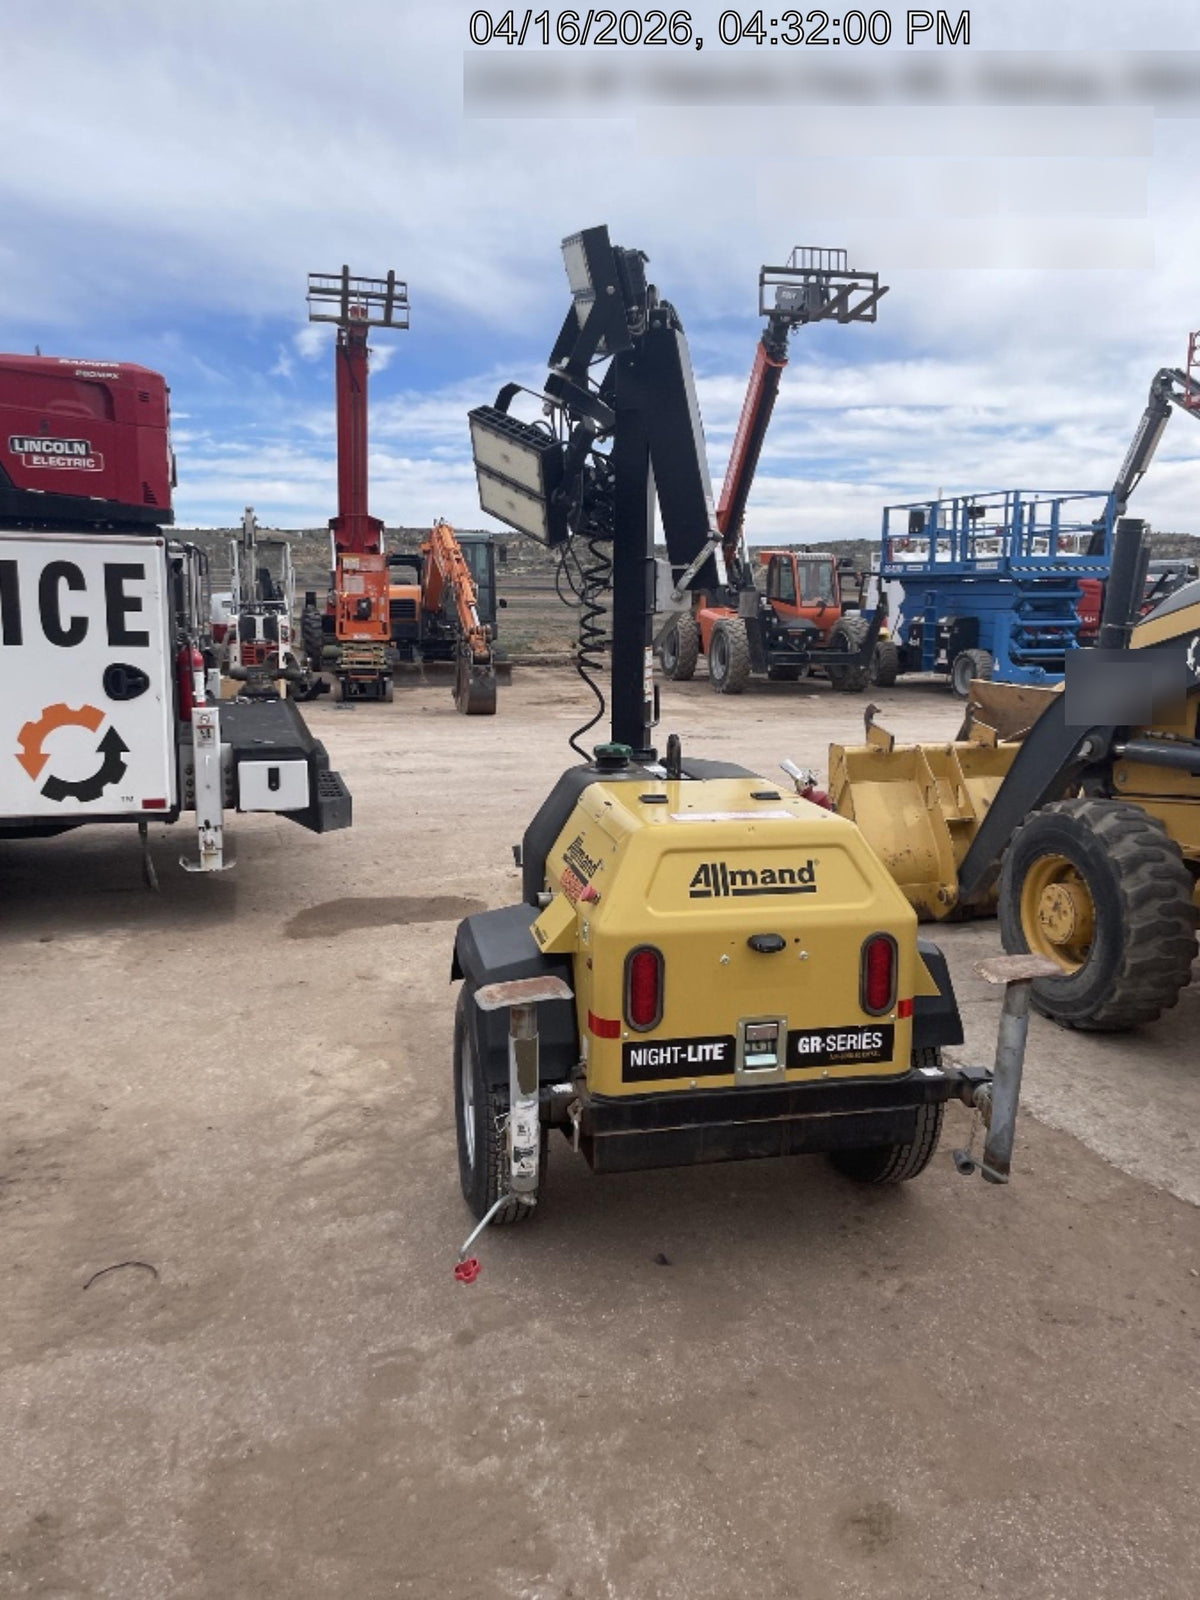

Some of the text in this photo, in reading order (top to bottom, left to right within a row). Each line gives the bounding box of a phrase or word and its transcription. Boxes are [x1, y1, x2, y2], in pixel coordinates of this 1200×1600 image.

[14, 438, 87, 456] LINCOLN
[32, 455, 96, 469] ELECTRIC
[0, 559, 150, 648] ICE
[689, 859, 817, 898] Allmand
[630, 1043, 726, 1068] NIGHT-LITE
